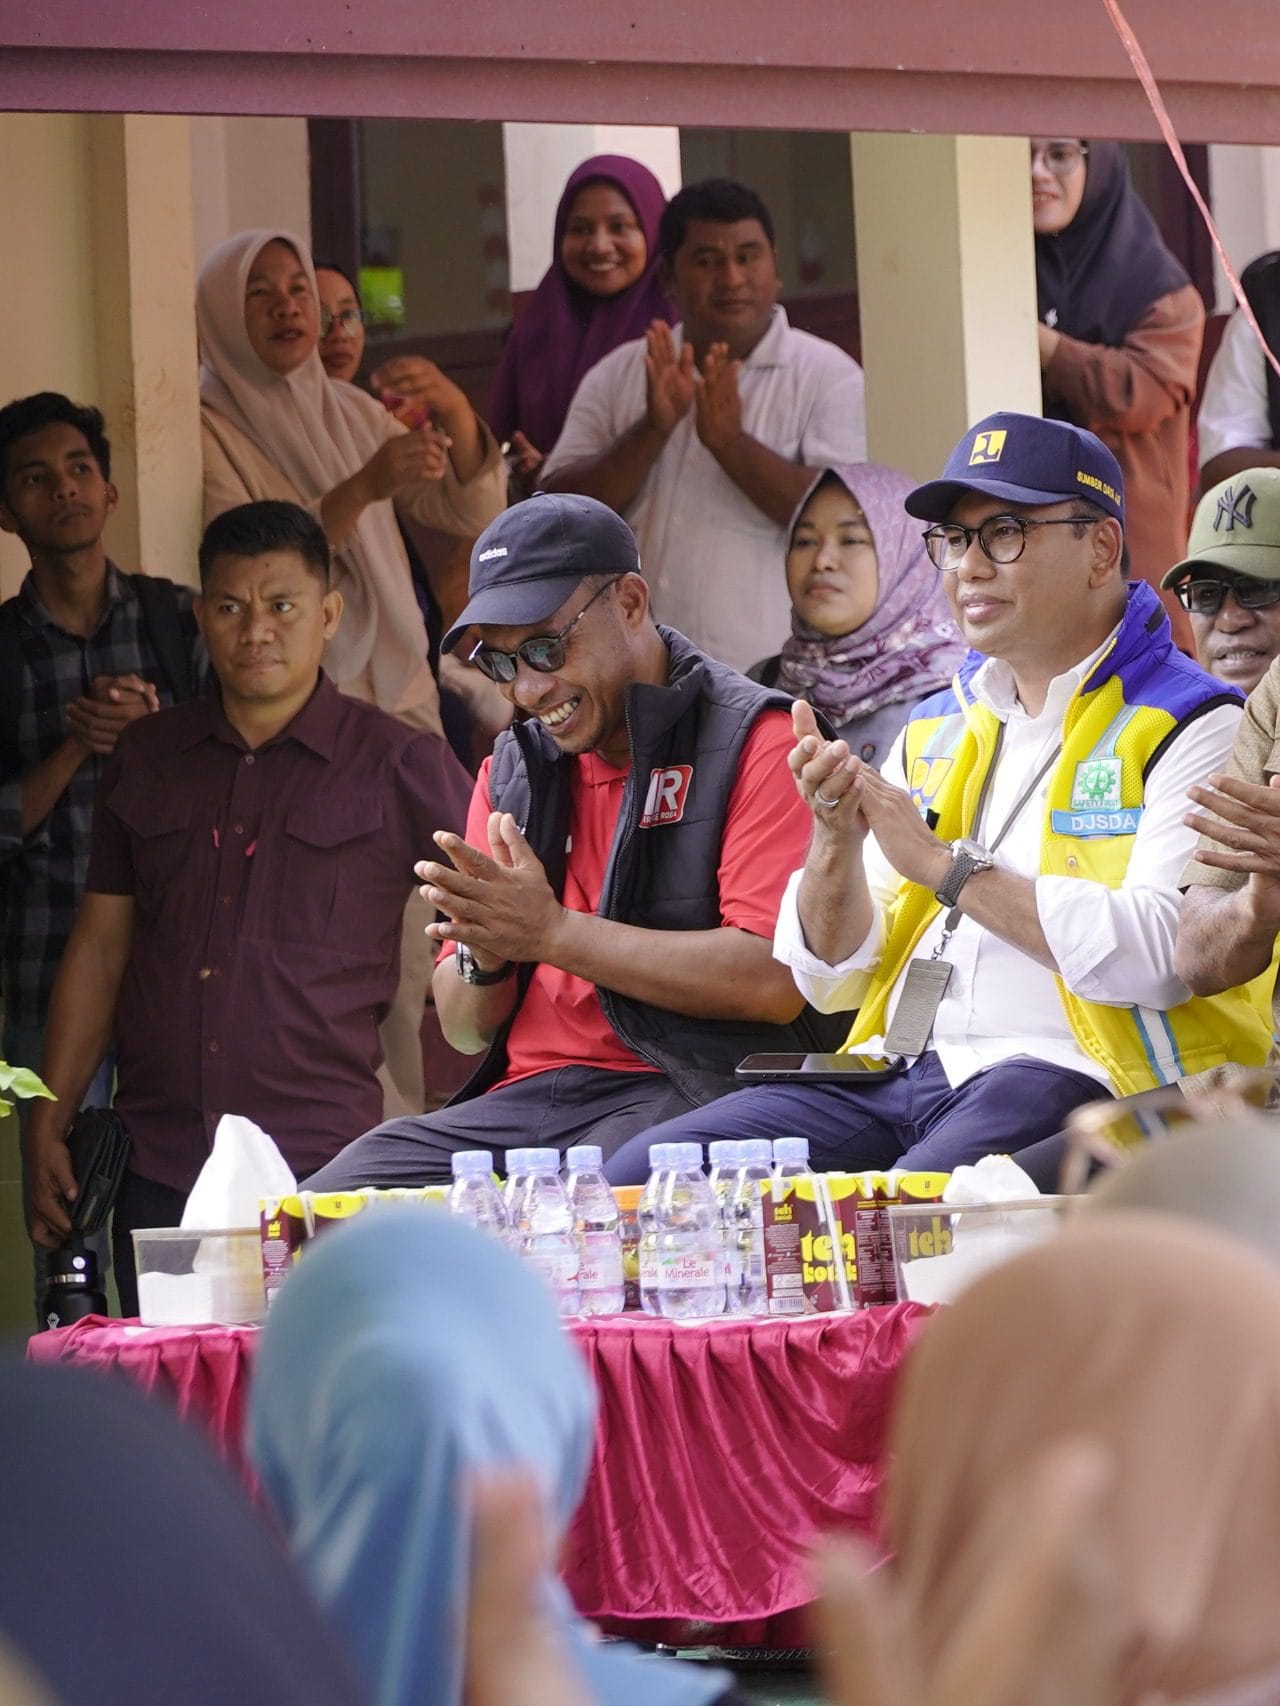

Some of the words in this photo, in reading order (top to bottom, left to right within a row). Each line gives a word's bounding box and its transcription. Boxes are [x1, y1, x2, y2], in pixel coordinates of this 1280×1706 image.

[1077, 471, 1102, 491] SUMBER
[479, 548, 508, 561] adidas
[1071, 813, 1138, 831] DJSDA
[683, 1257, 697, 1269] Le
[665, 1268, 710, 1279] Minerale
